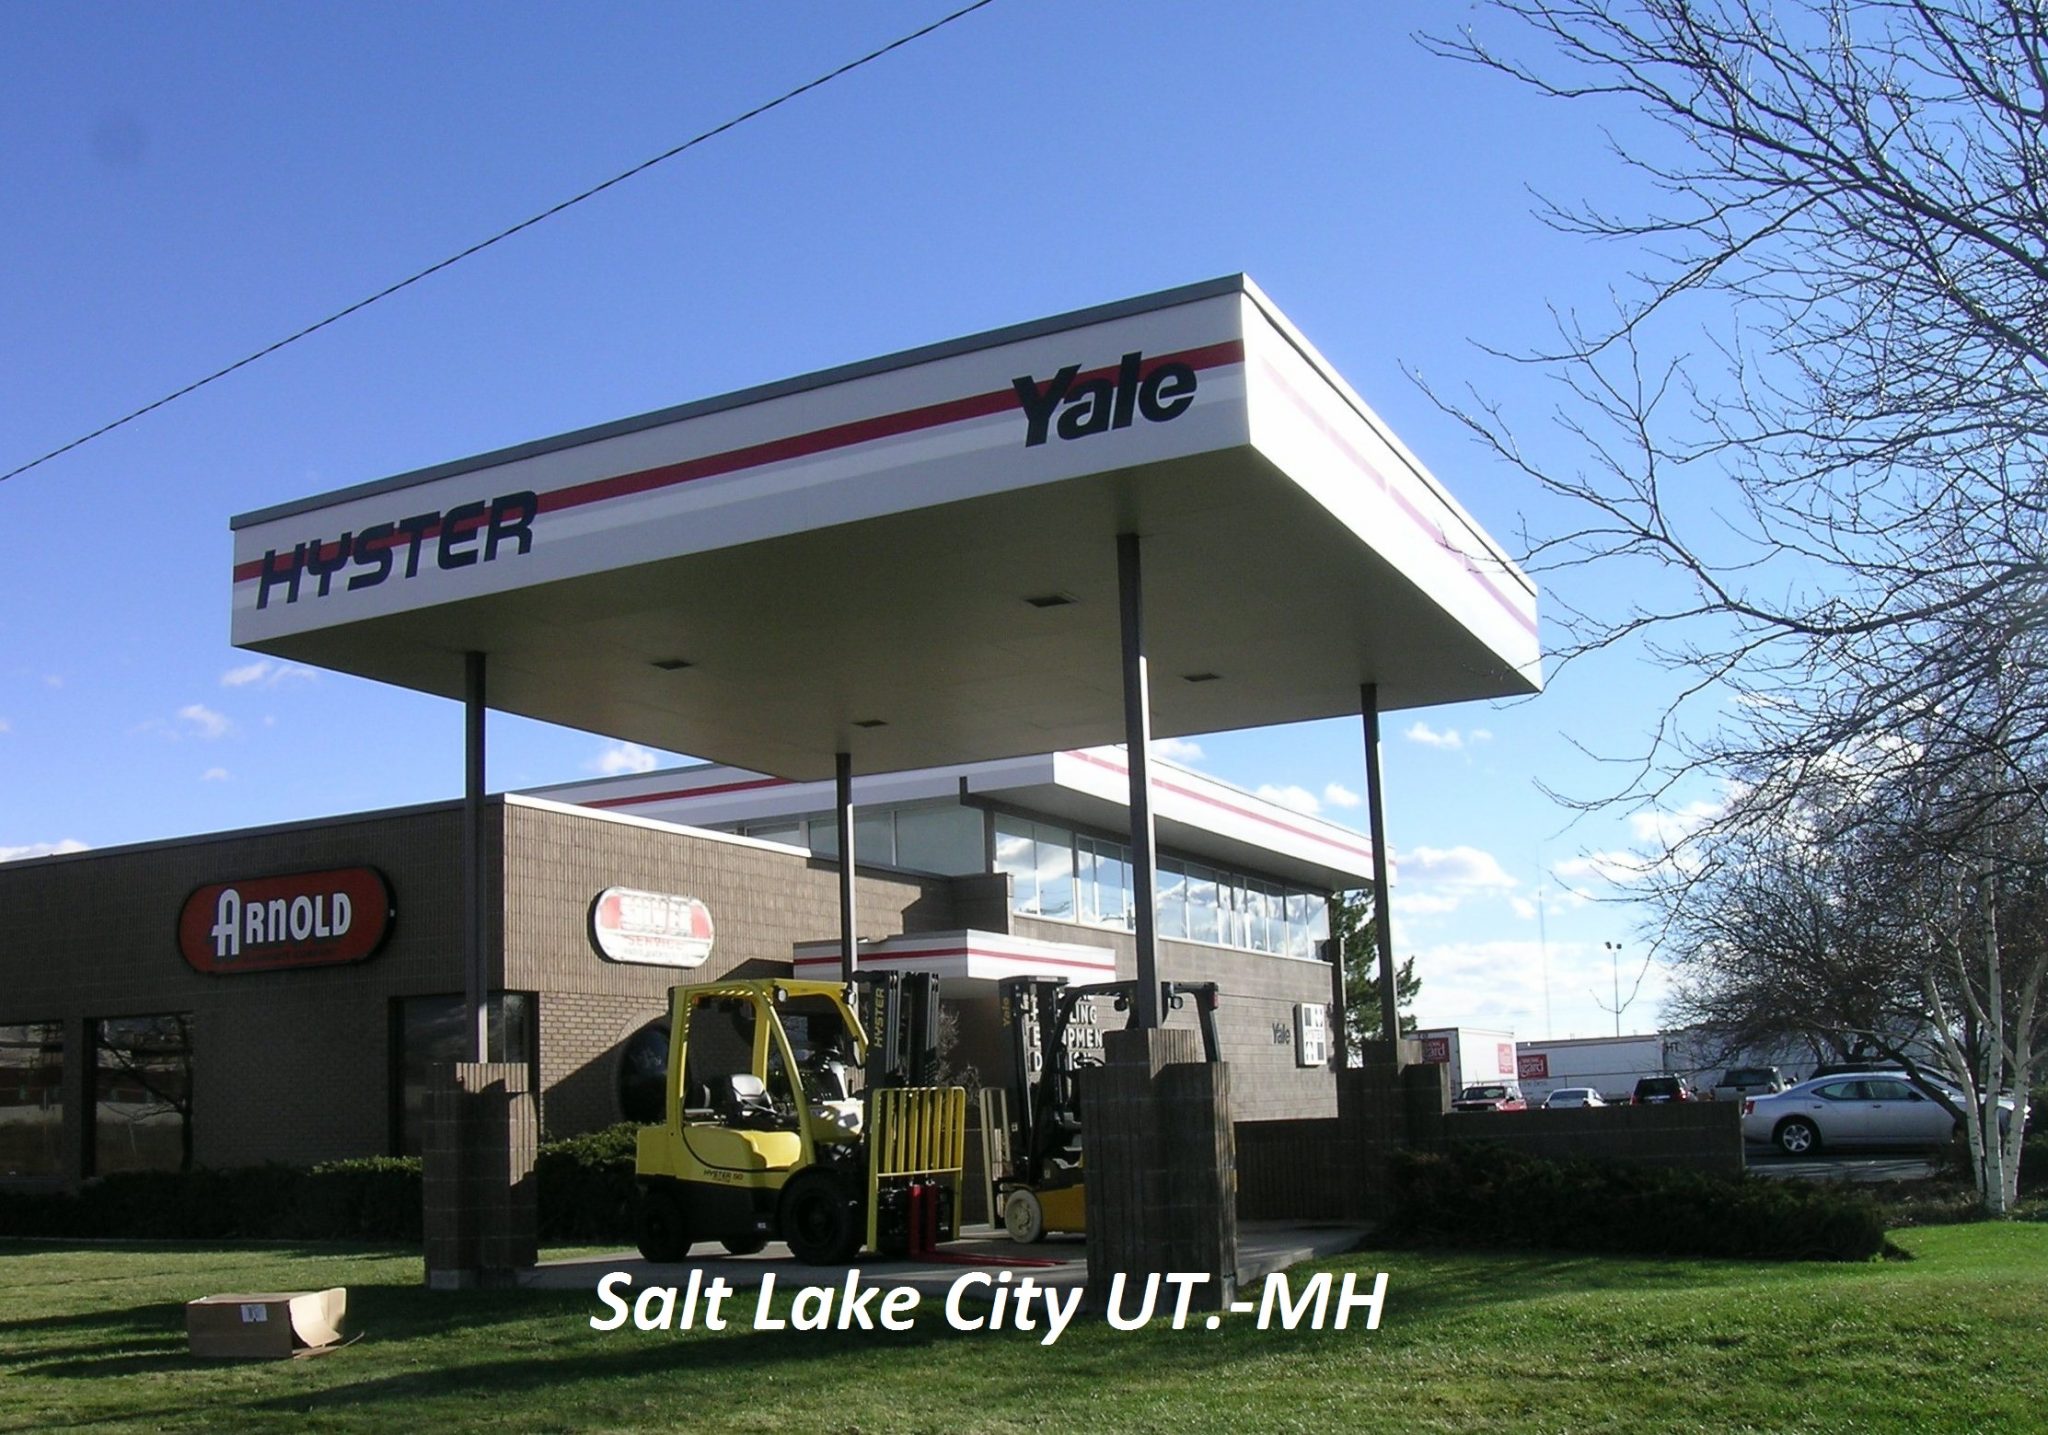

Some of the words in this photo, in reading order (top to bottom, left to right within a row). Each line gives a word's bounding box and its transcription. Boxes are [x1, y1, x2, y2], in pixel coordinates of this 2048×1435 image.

[1012, 351, 1198, 448] Yale
[256, 490, 538, 610] HYSTER
[211, 889, 352, 957] ARNOLD
[874, 987, 885, 1049] HYSTER
[1002, 996, 1011, 1027] Yale
[1272, 1022, 1292, 1045] Yale
[703, 1168, 732, 1179] HYSTER
